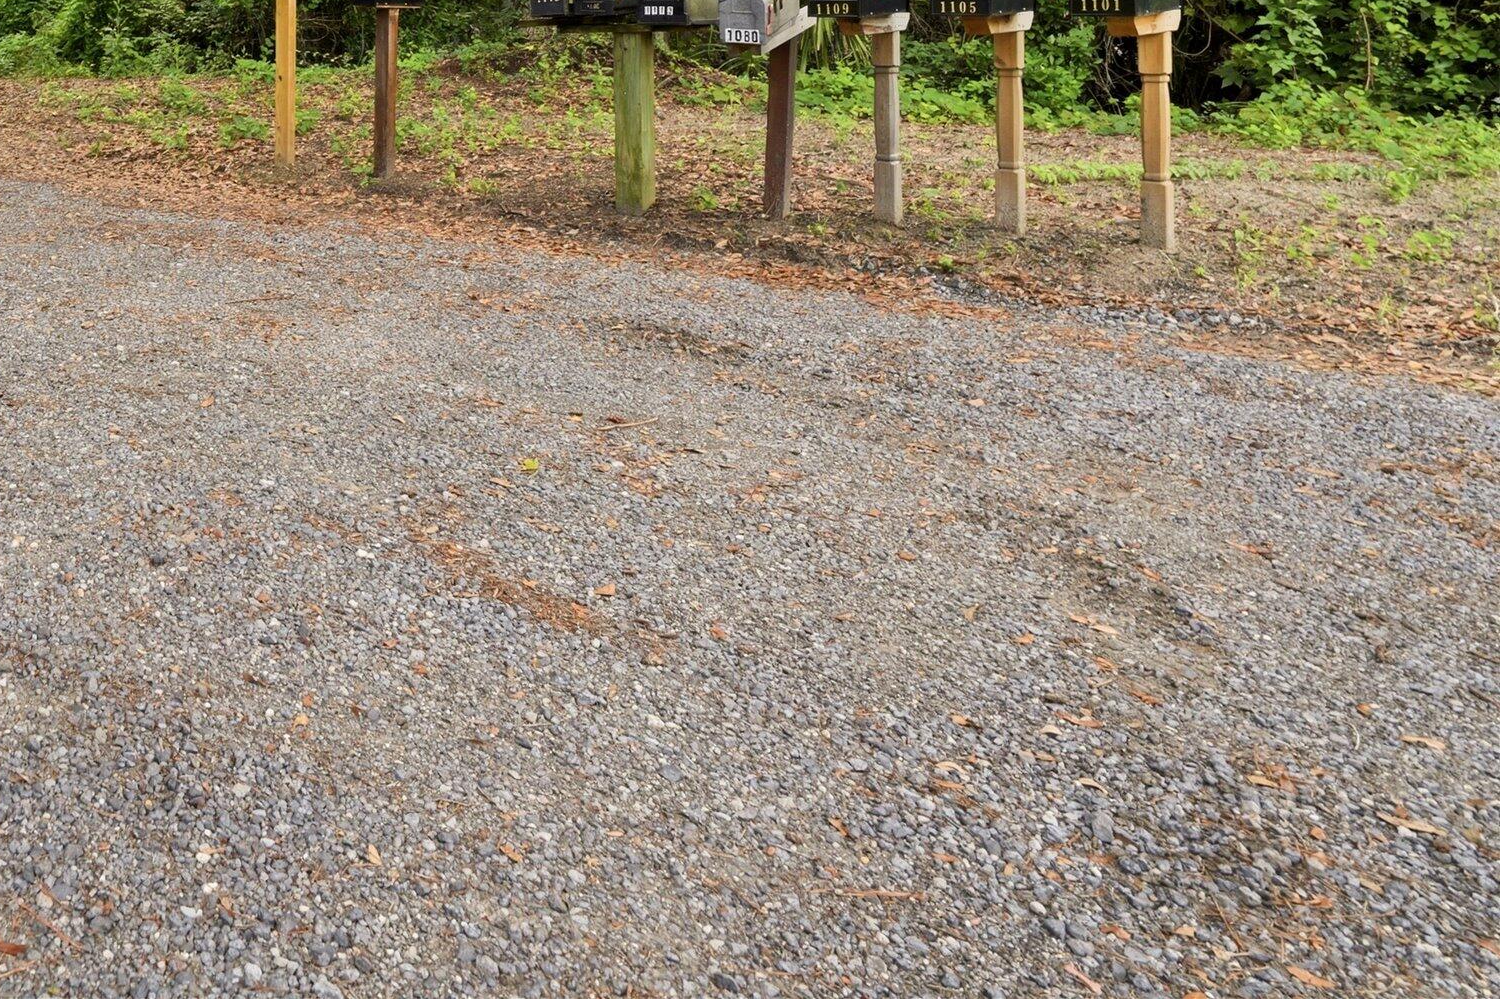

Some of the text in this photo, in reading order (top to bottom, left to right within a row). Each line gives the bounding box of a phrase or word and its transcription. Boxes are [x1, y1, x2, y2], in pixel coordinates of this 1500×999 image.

[816, 3, 849, 15] 1109
[940, 1, 977, 14] 1105
[727, 30, 758, 42] 1080
